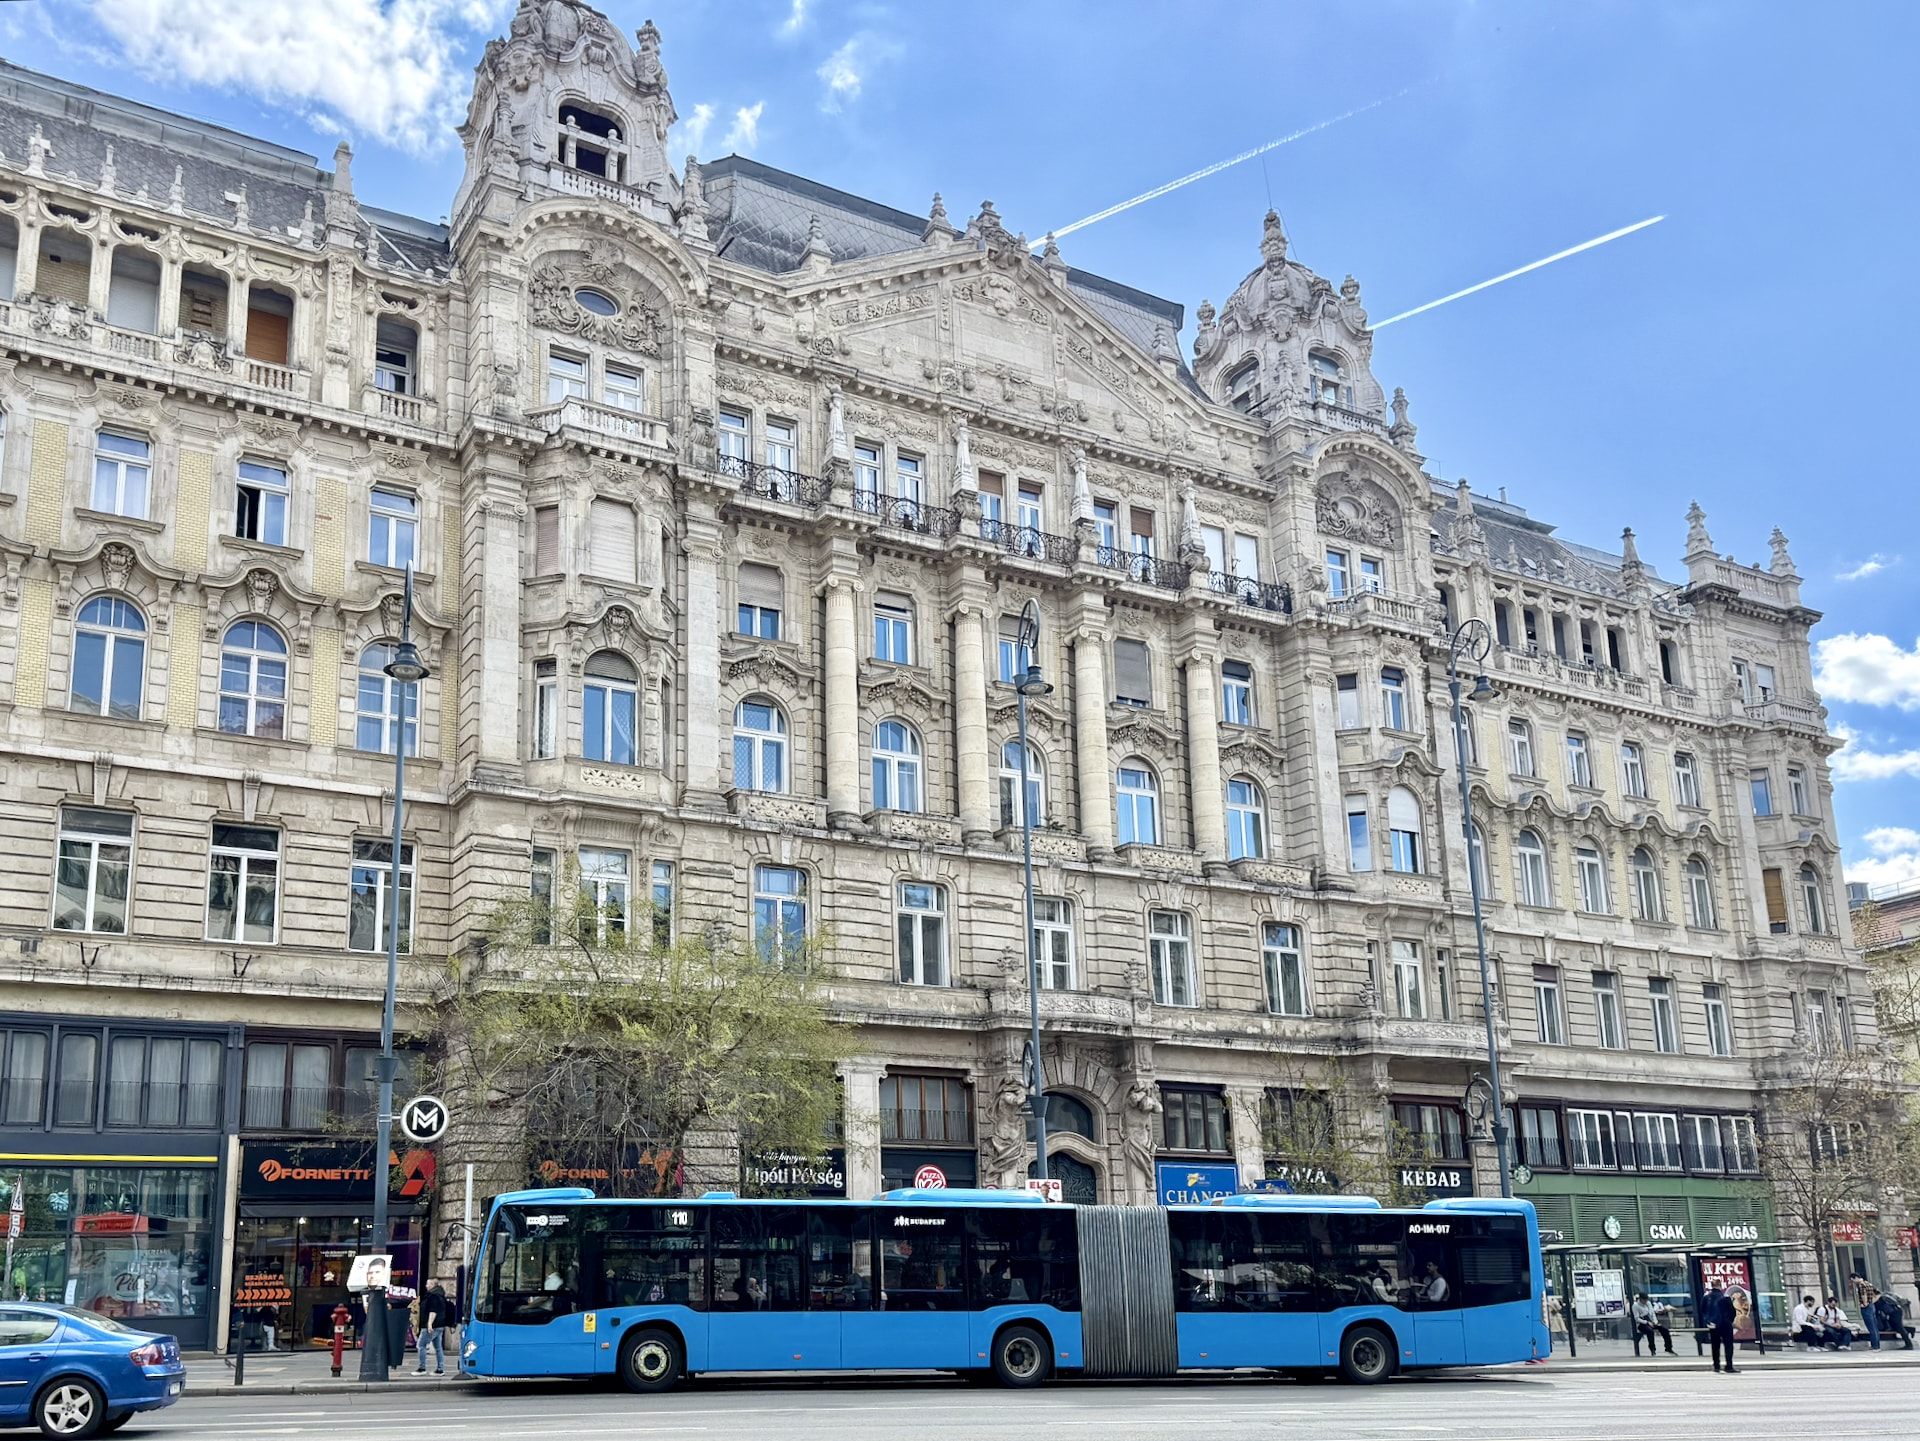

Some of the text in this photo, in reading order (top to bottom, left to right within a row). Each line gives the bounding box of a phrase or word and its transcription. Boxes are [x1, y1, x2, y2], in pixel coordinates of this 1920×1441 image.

[281, 1168, 369, 1180] FORNETTI
[558, 1168, 635, 1179] FORNETI
[1402, 1171, 1461, 1187] KEBAB
[672, 1212, 688, 1225] 110
[1650, 1225, 1686, 1239] CSAK
[1717, 1222, 1758, 1239] VÁGÁS
[1714, 1262, 1744, 1275] KFC
